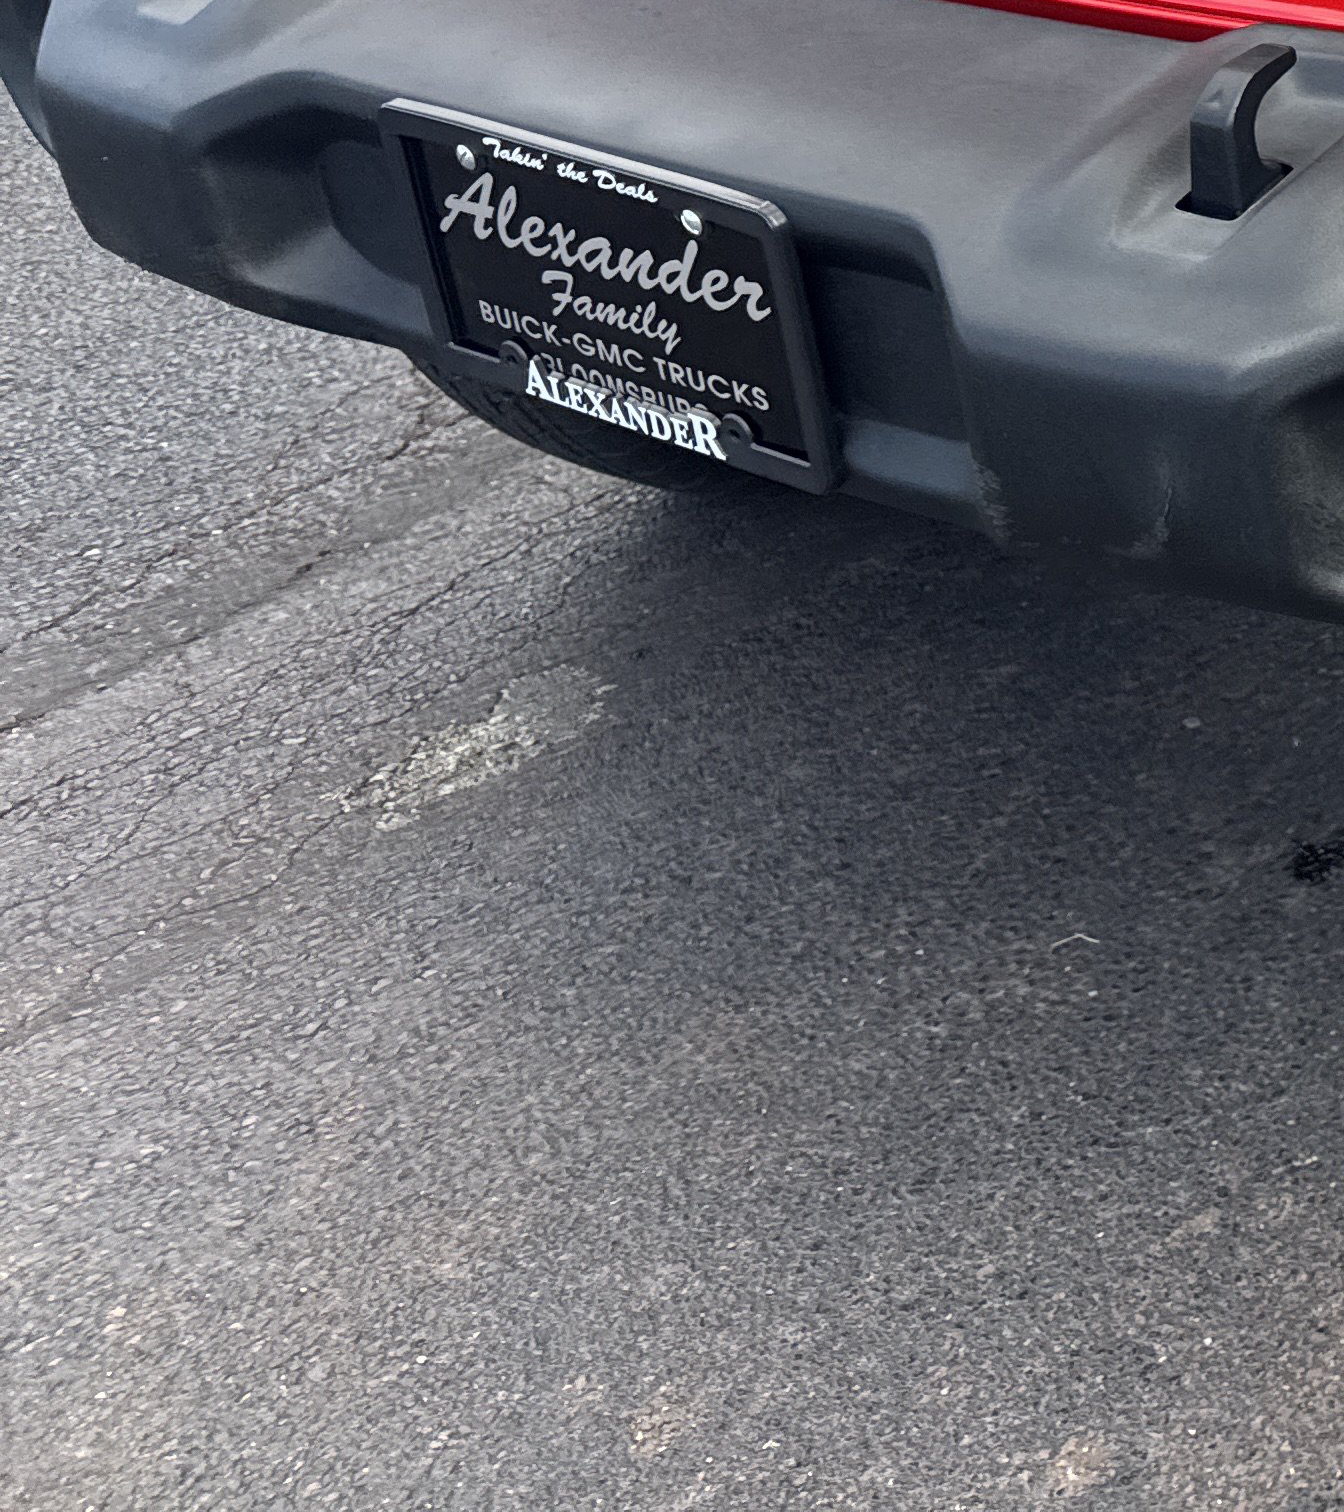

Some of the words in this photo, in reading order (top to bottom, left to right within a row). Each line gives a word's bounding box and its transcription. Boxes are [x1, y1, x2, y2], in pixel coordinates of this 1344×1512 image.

[482, 137, 548, 170] Takin'
[557, 162, 588, 183] the
[592, 169, 658, 203] Deals
[440, 172, 771, 321] Alexander
[478, 299, 647, 373] BUICK-GMC
[653, 356, 770, 411] TRUCKS
[541, 270, 682, 354] Family
[525, 357, 727, 461] ALEXANDER
[540, 352, 710, 414] LOOMSBUR
